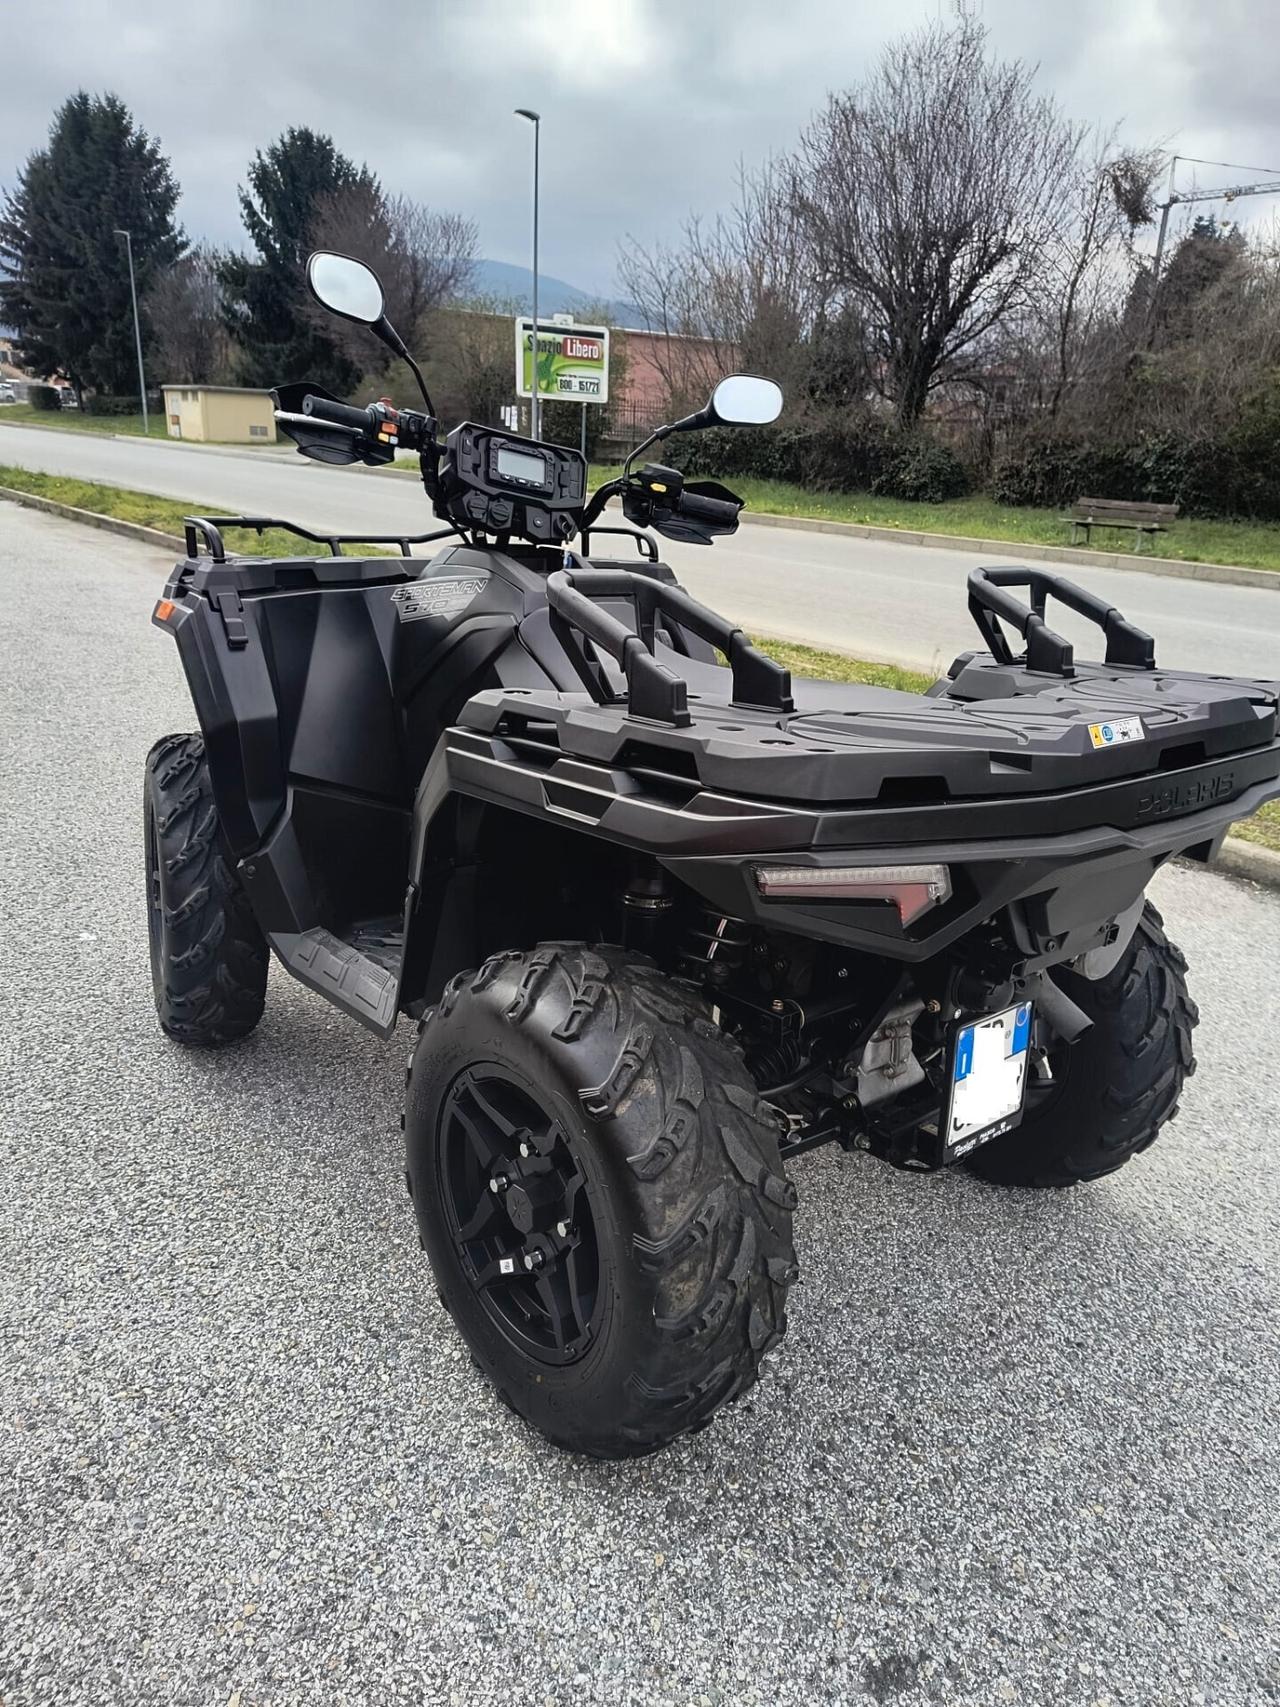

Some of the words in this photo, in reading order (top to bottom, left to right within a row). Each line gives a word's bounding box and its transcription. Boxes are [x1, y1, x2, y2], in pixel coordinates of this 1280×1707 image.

[567, 339, 599, 359] Libero
[560, 379, 572, 390] 800
[390, 579, 489, 602] SPORTSMAN
[403, 600, 449, 614] 570
[1135, 772, 1234, 818] POLARIS
